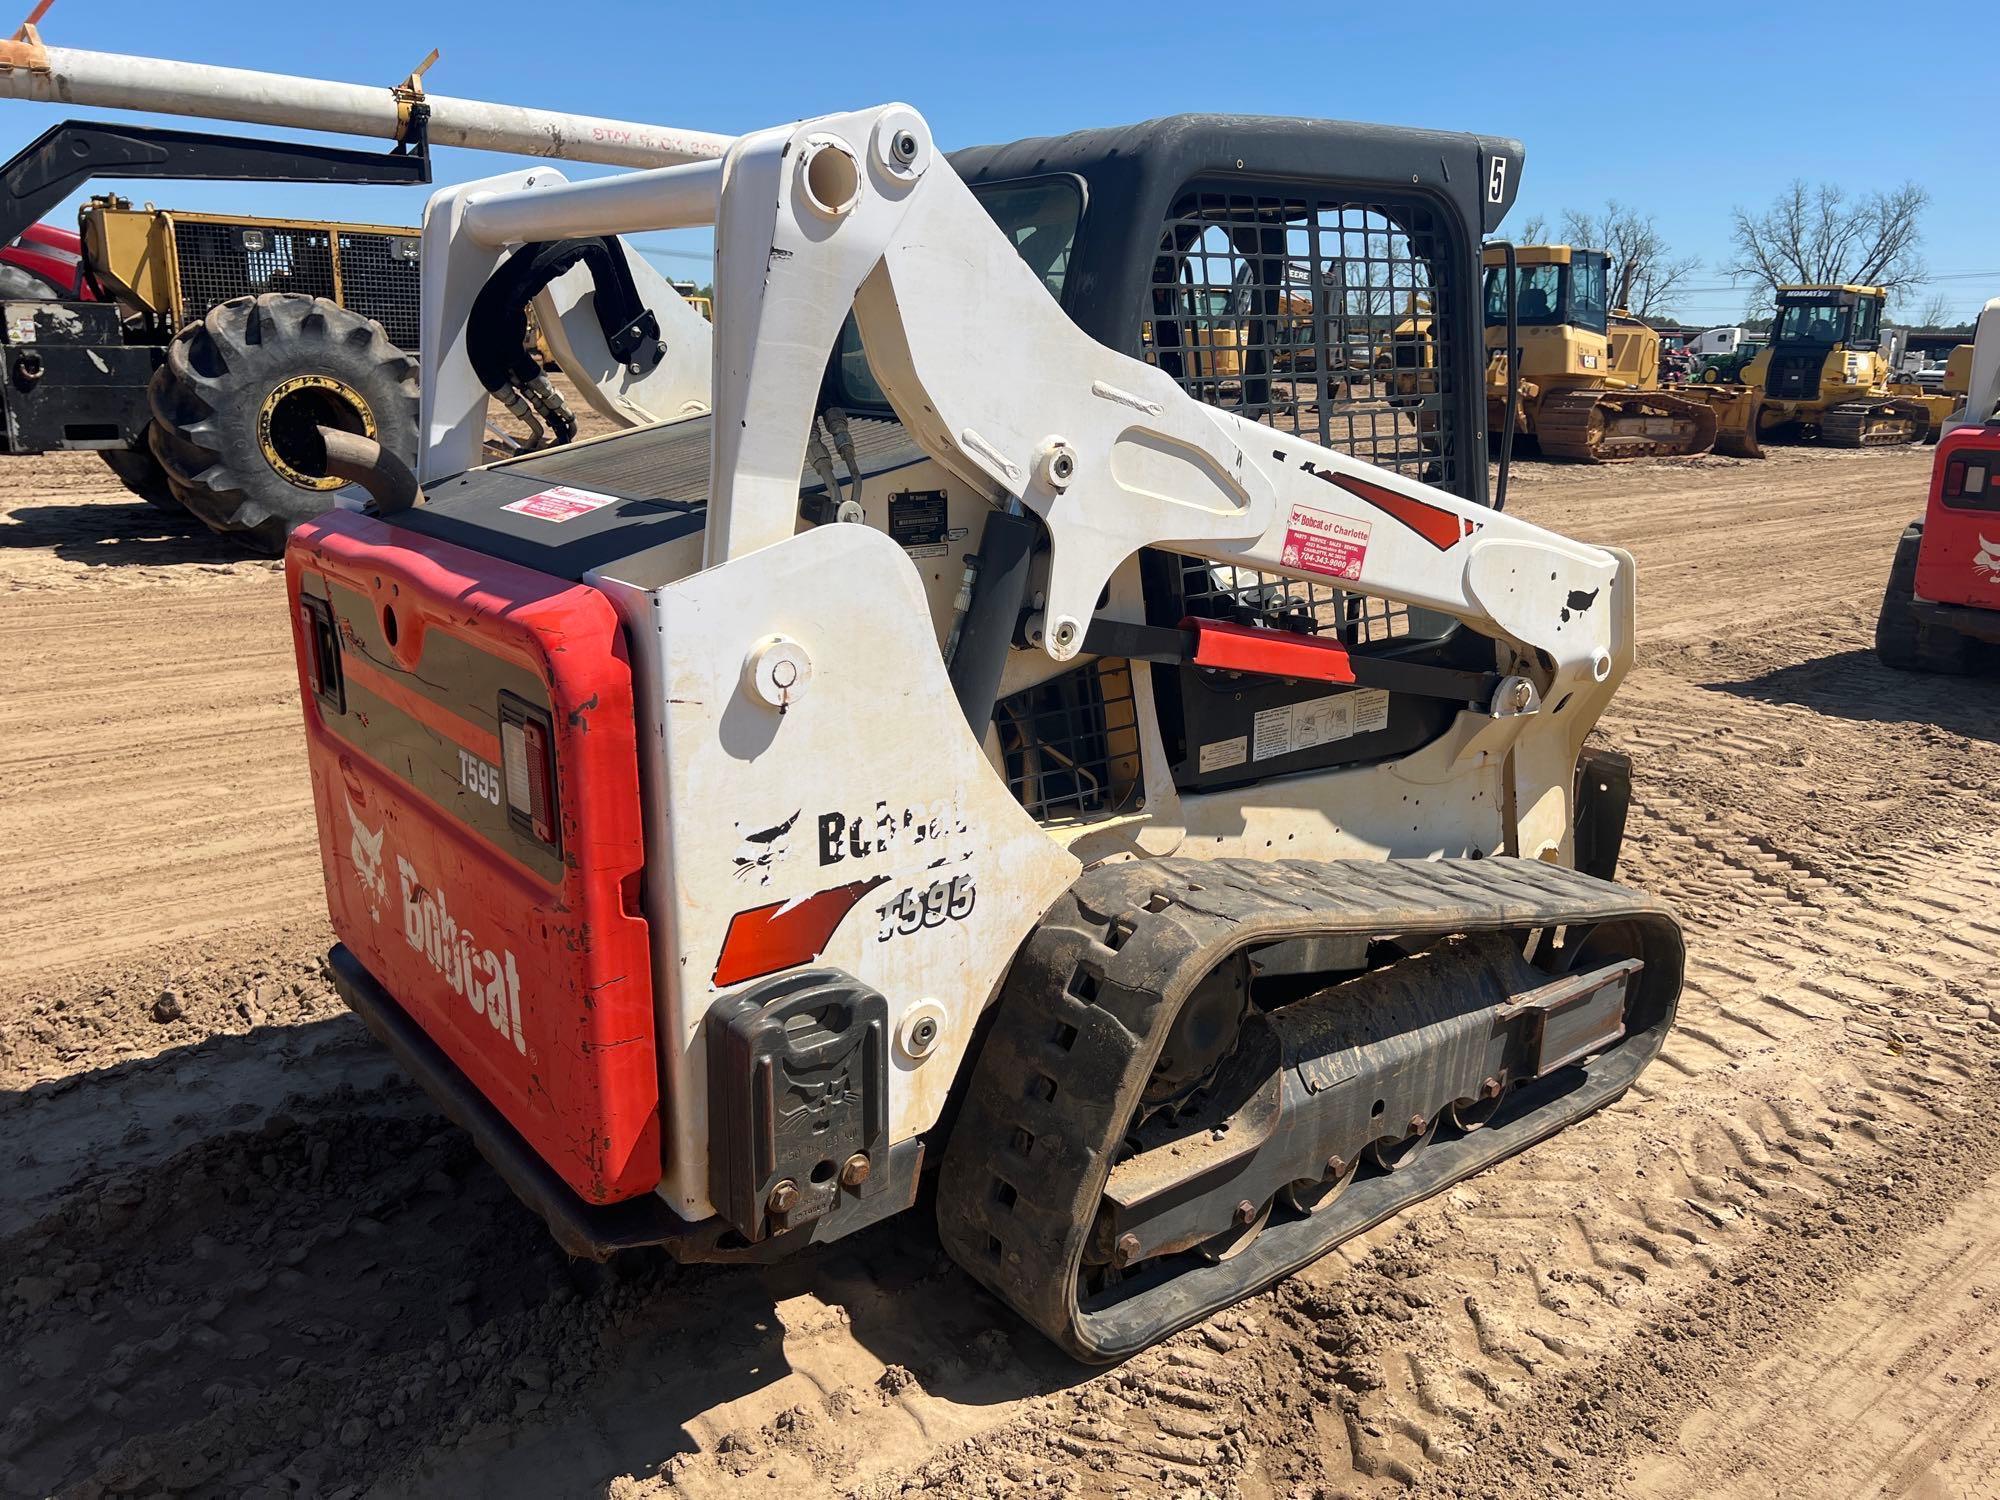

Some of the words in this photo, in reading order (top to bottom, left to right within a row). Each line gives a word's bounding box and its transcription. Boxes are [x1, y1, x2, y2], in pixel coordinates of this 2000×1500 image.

[592, 128, 631, 144] STAY
[1491, 159, 1503, 200] 5
[1289, 269, 1309, 280] EERE
[1786, 289, 1831, 298] KOMATSU
[1584, 355, 1596, 369] CAT
[1301, 515, 1323, 530] Bobcat
[1324, 523, 1332, 531] of
[1334, 525, 1367, 540] Charlotte
[1301, 552, 1346, 568] 704-343-9000
[458, 749, 500, 805] T595
[818, 785, 968, 867] Bobc
[876, 873, 977, 943] T595
[396, 854, 527, 1057] Bobcat
